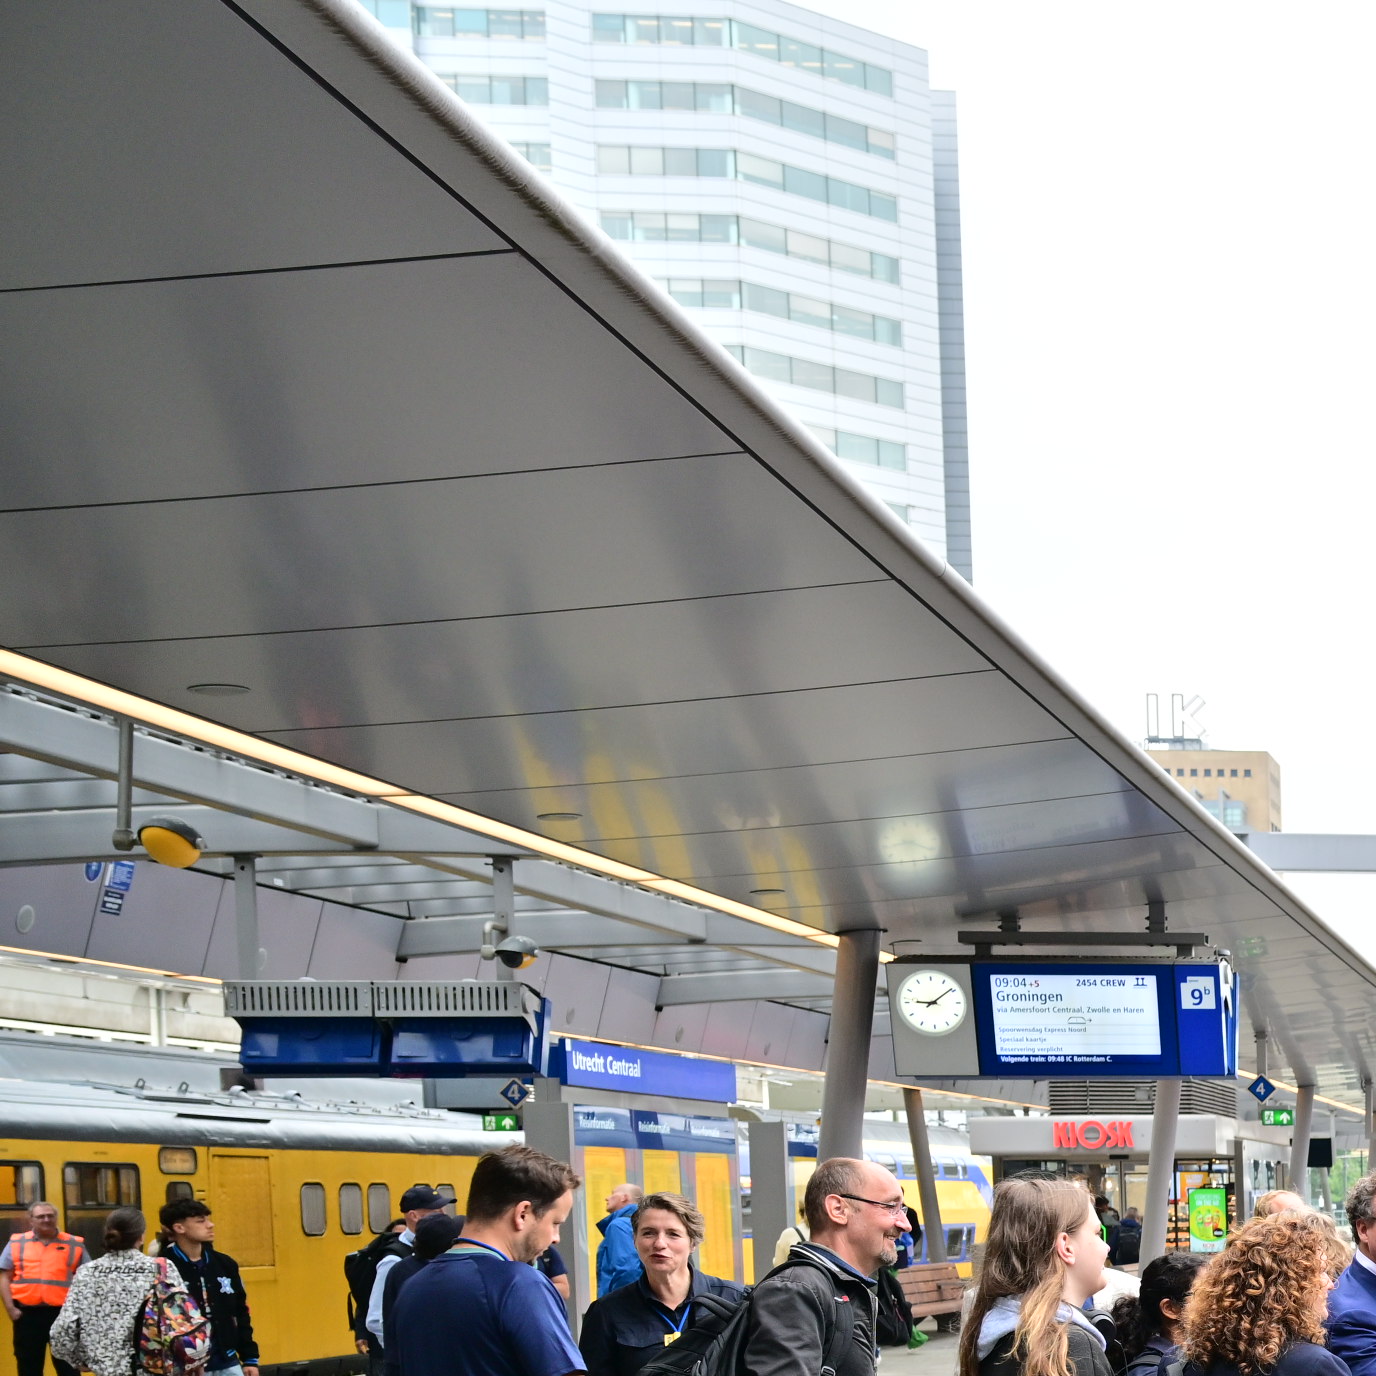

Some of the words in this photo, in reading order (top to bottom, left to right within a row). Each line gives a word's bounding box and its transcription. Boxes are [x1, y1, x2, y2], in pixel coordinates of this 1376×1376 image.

[995, 977, 1027, 988] 09:04
[1076, 979, 1097, 987] 2454
[1100, 979, 1126, 987] CREW
[996, 990, 1063, 1004] Groningen
[1052, 1006, 1085, 1014] Centraal,
[572, 1050, 605, 1073] Utrecht
[606, 1055, 641, 1077] Centraal
[1001, 1055, 1029, 1063] Volgende
[508, 1084, 520, 1099] 4
[1256, 1082, 1266, 1095] 4
[1053, 1120, 1134, 1149] KIOSK
